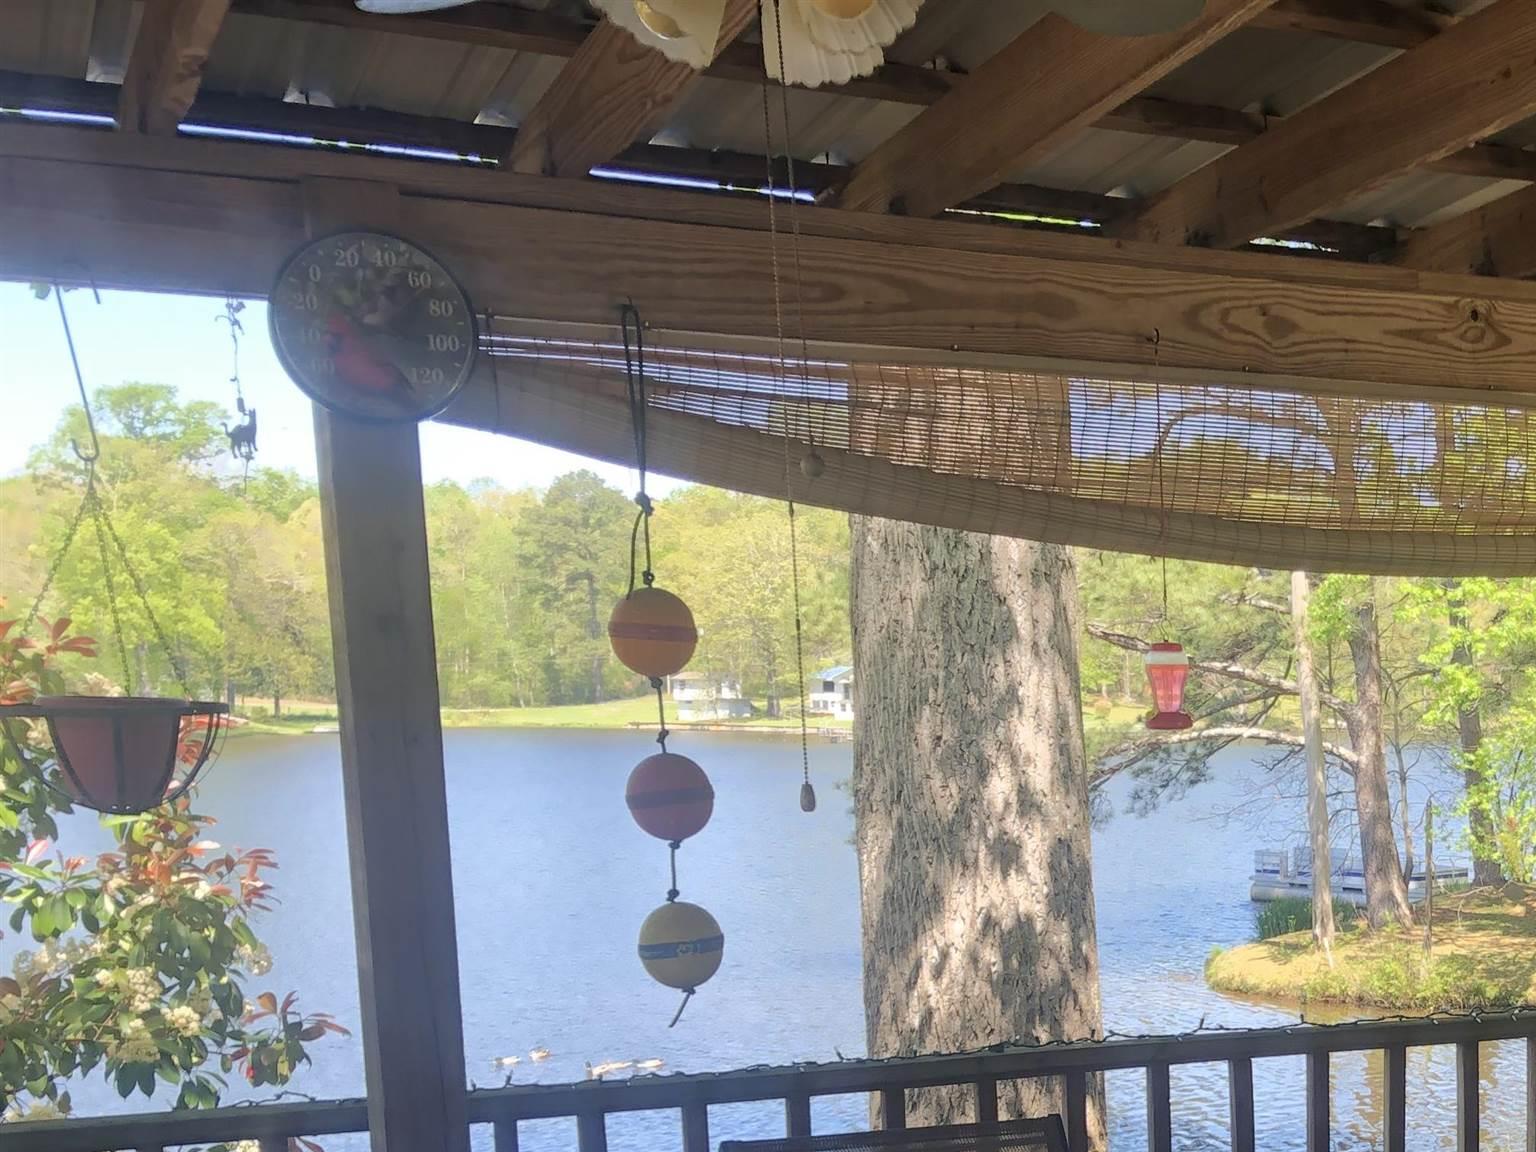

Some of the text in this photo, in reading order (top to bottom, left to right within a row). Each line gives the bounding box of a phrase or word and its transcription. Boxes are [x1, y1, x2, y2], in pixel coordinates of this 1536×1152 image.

[335, 249, 359, 267] 20
[371, 250, 396, 267] 40
[309, 264, 321, 282] 0
[408, 271, 431, 288] 60
[429, 299, 452, 317] 80
[427, 334, 459, 351] 100
[409, 367, 444, 385] 120
